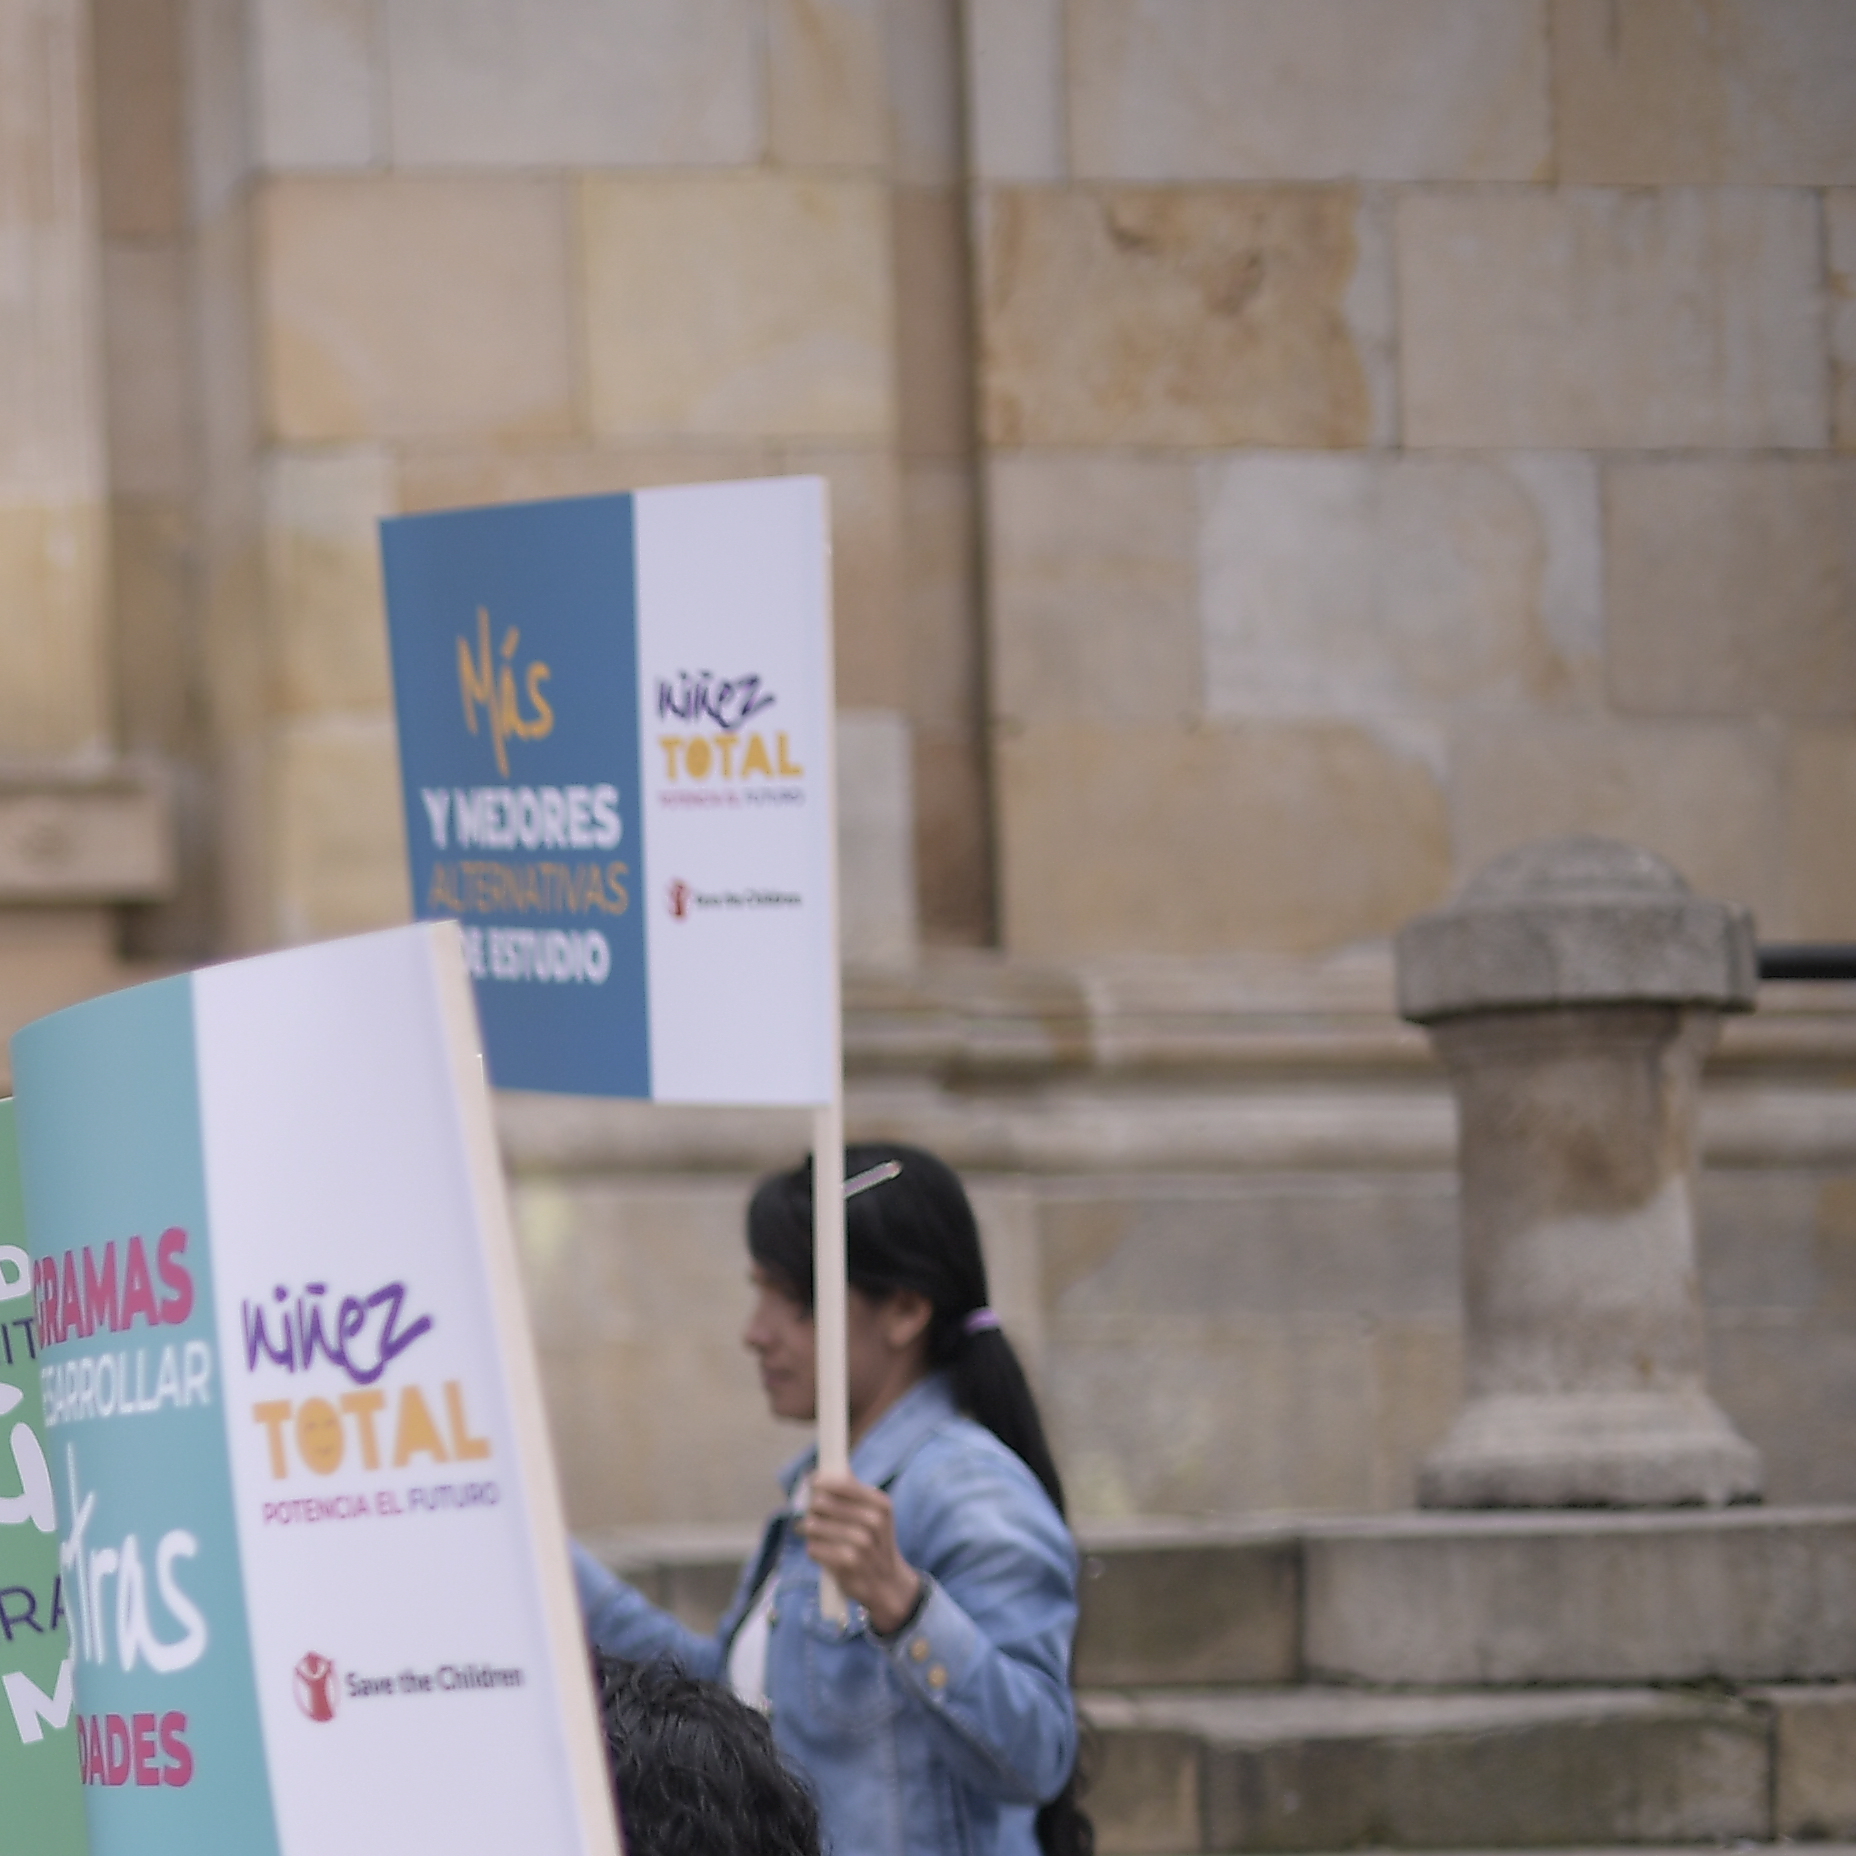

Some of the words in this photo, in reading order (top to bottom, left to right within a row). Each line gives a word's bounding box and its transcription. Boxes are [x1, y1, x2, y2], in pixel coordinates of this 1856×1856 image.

[456, 604, 555, 779] Más
[658, 732, 806, 780] TOTAL
[421, 787, 451, 850] Y
[454, 784, 624, 850] MEJORES
[428, 860, 630, 916] ALTERNATIVAS
[489, 927, 611, 985] ESTUDIO
[242, 1280, 435, 1385] niñez
[251, 1378, 492, 1481] TOTAL
[262, 1495, 370, 1526] POTENCIA
[373, 1490, 404, 1518] EL
[59, 1442, 209, 1674] tras
[346, 1671, 394, 1698] Save
[397, 1669, 434, 1694] the
[436, 1664, 524, 1691] Children
